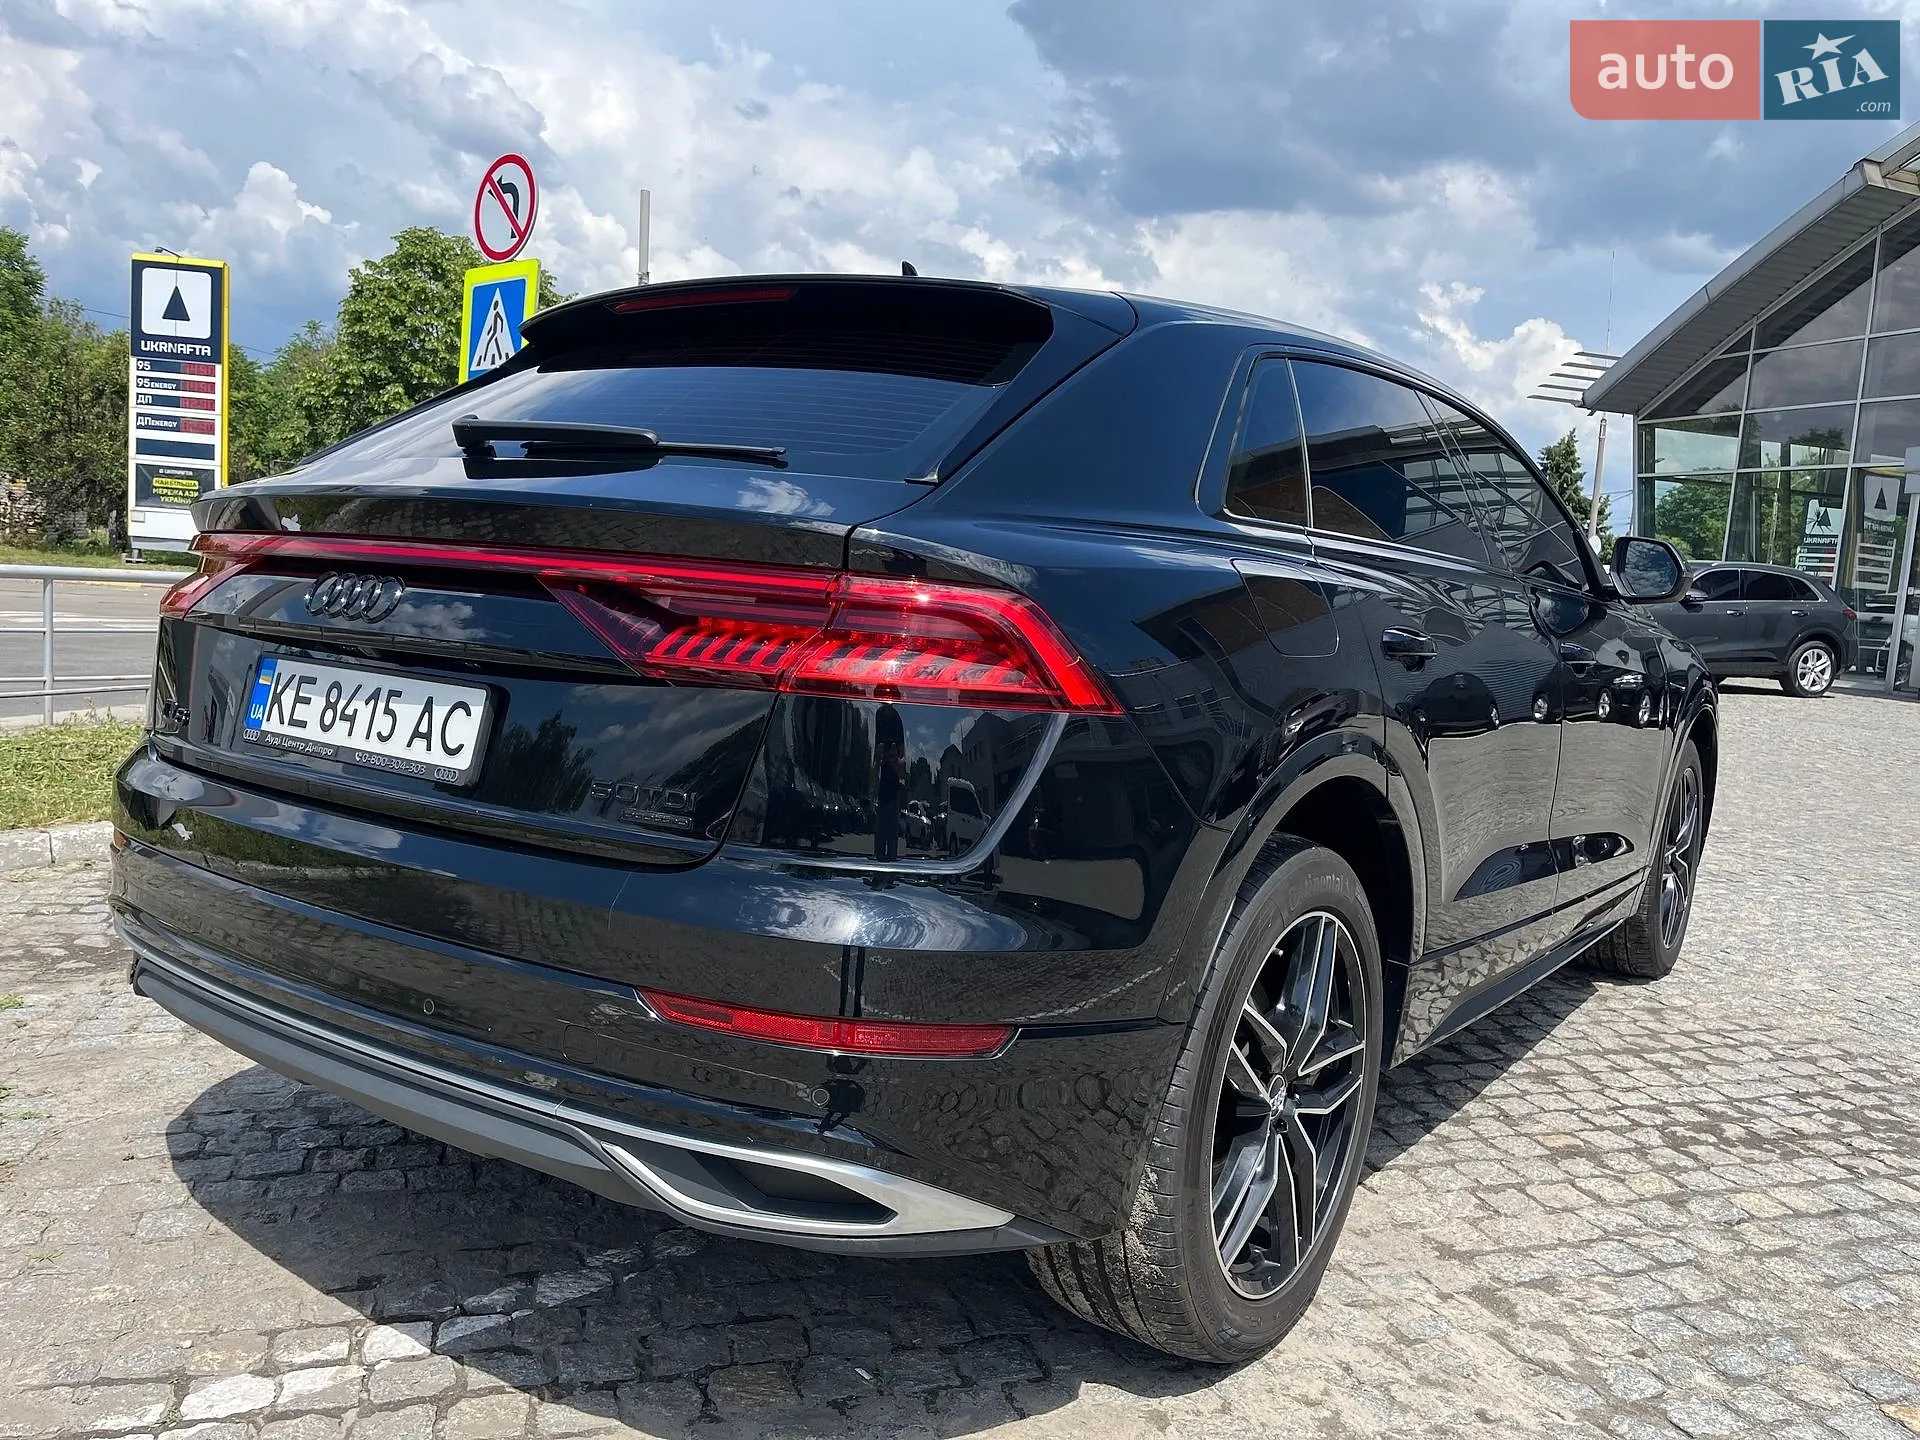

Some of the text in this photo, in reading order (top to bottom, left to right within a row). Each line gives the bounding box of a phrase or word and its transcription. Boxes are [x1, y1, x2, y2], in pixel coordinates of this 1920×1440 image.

[140, 339, 212, 357] UKRNAFTA
[136, 360, 152, 371] 95
[137, 394, 153, 405] ДП
[250, 703, 264, 721] UA
[266, 671, 472, 757] KE 8415 AC
[265, 733, 334, 756] Ауді Центр Дніпро
[362, 753, 426, 775] 0-800-304-303
